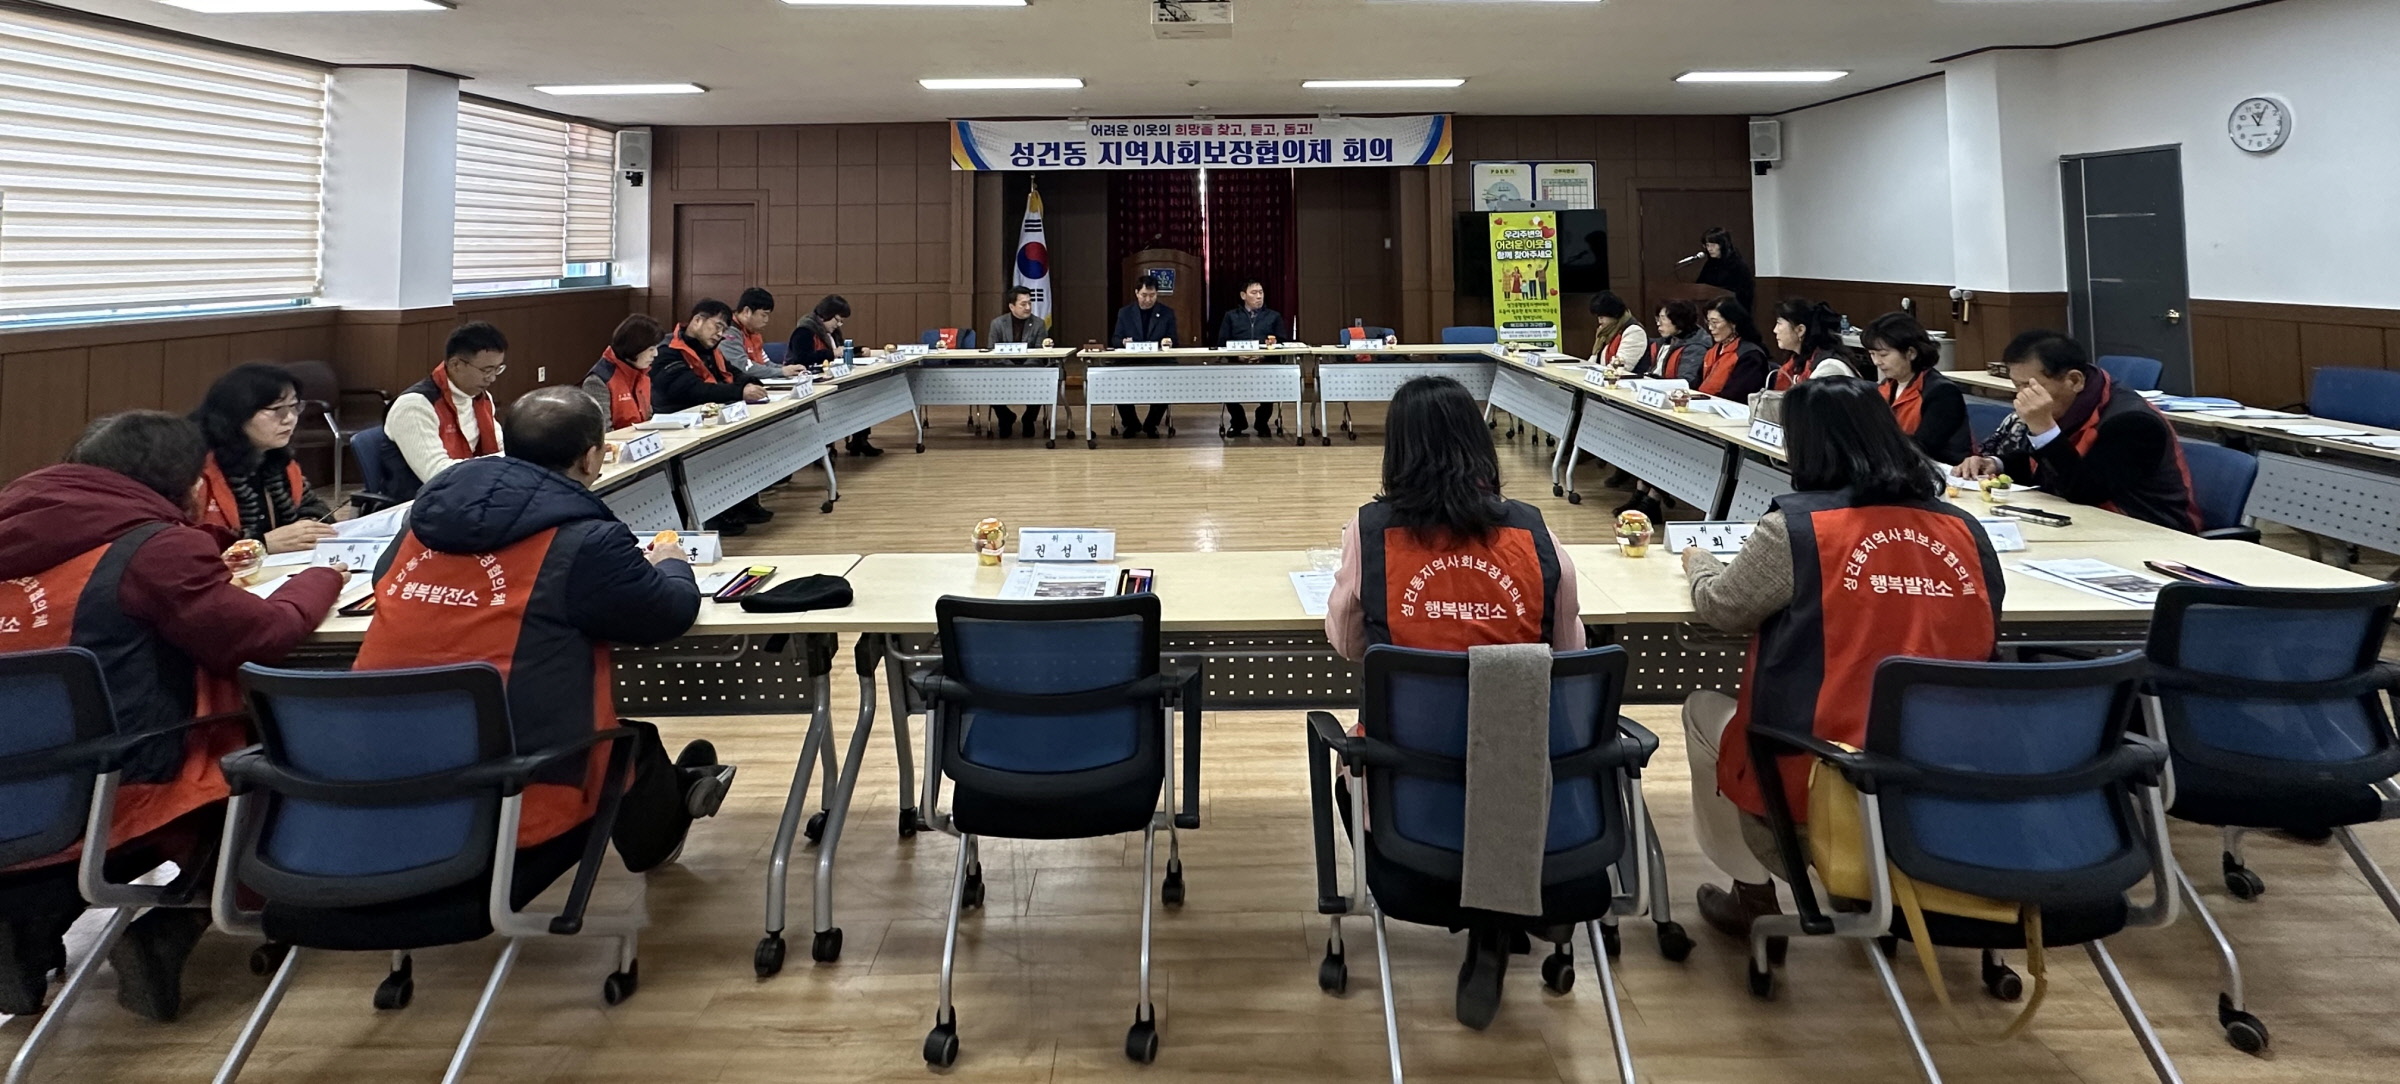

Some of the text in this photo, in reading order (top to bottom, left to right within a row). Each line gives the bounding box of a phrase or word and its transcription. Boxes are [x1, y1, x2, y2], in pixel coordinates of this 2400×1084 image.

[1090, 124, 1313, 138] 어려운 이웃의 희망을 찾고, 듣고, 돕고!
[1010, 138, 1394, 166] 성건동 지역사회보장협의체 회의
[1496, 239, 1552, 249] 어려운 이웃을
[1504, 230, 1543, 239] 우리주변의
[1514, 250, 1553, 259] 찾아주세요
[1843, 527, 1976, 596] 성건동지역사회보장협의체
[400, 581, 480, 607] 행복발전소
[1400, 555, 1526, 618] 성건동지역사회보장협의체
[1869, 574, 1955, 598] 행복발전소
[1424, 600, 1509, 620] 행복발전소
